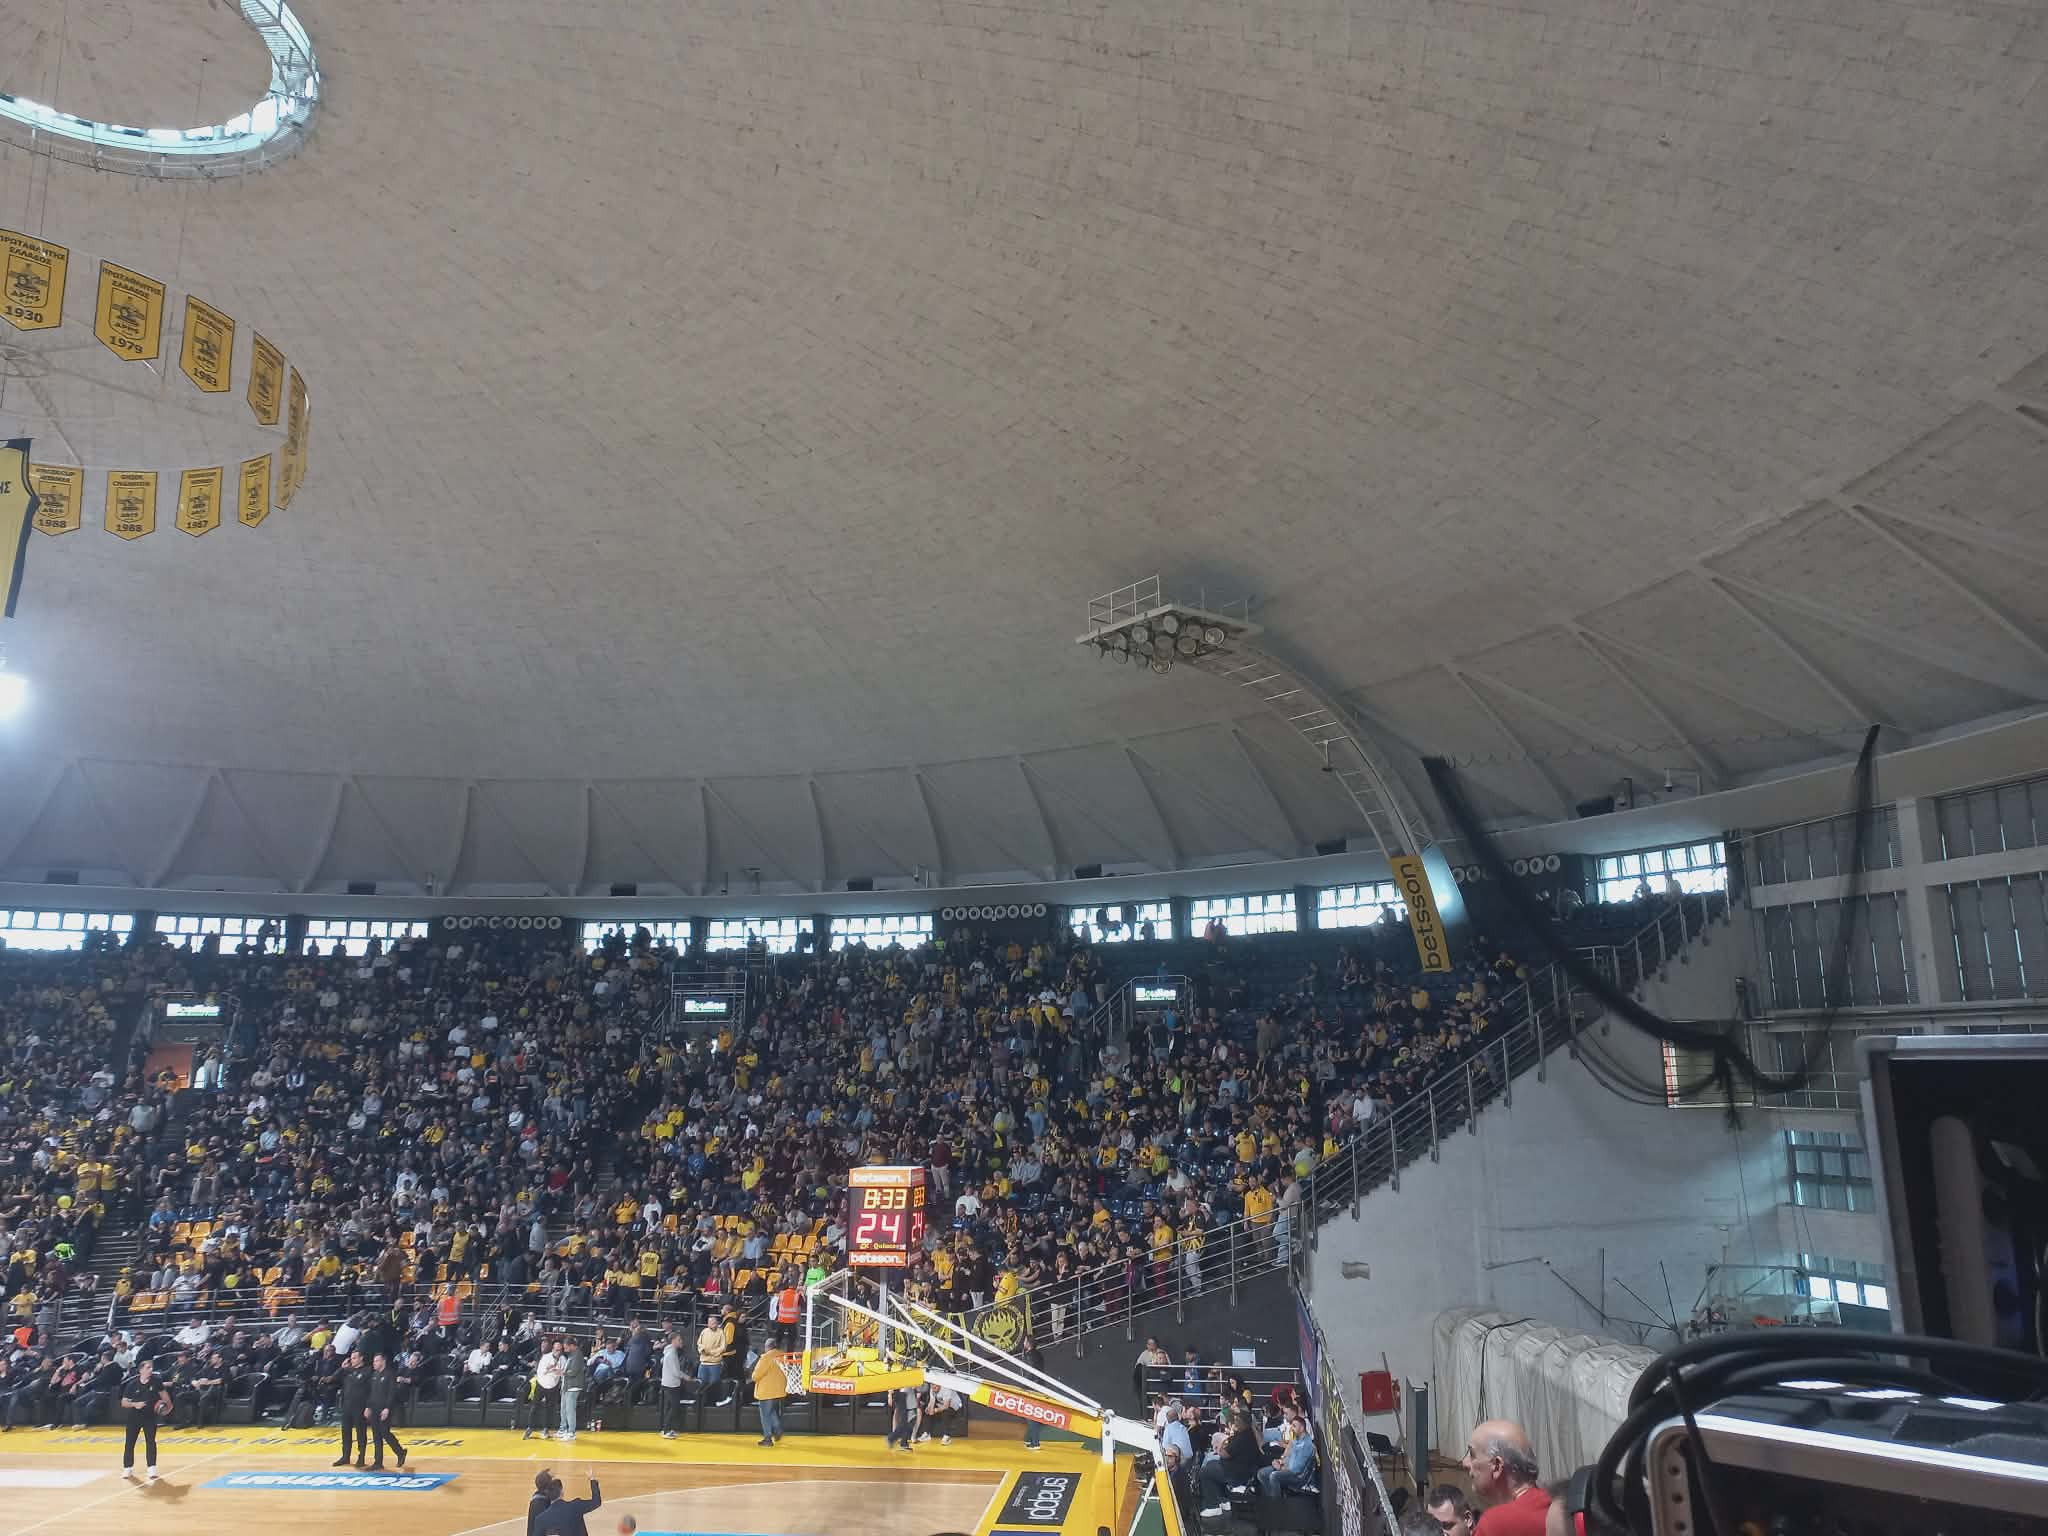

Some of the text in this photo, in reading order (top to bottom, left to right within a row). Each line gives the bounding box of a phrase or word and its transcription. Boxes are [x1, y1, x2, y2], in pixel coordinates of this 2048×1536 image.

[5, 305, 44, 324] 1930
[1400, 863, 1442, 969] betsson
[863, 1188, 908, 1210] 8:33
[856, 1212, 901, 1244] 24
[812, 1378, 854, 1392] betsson
[993, 1391, 1066, 1426] betsson
[1023, 1477, 1069, 1520] snappi
